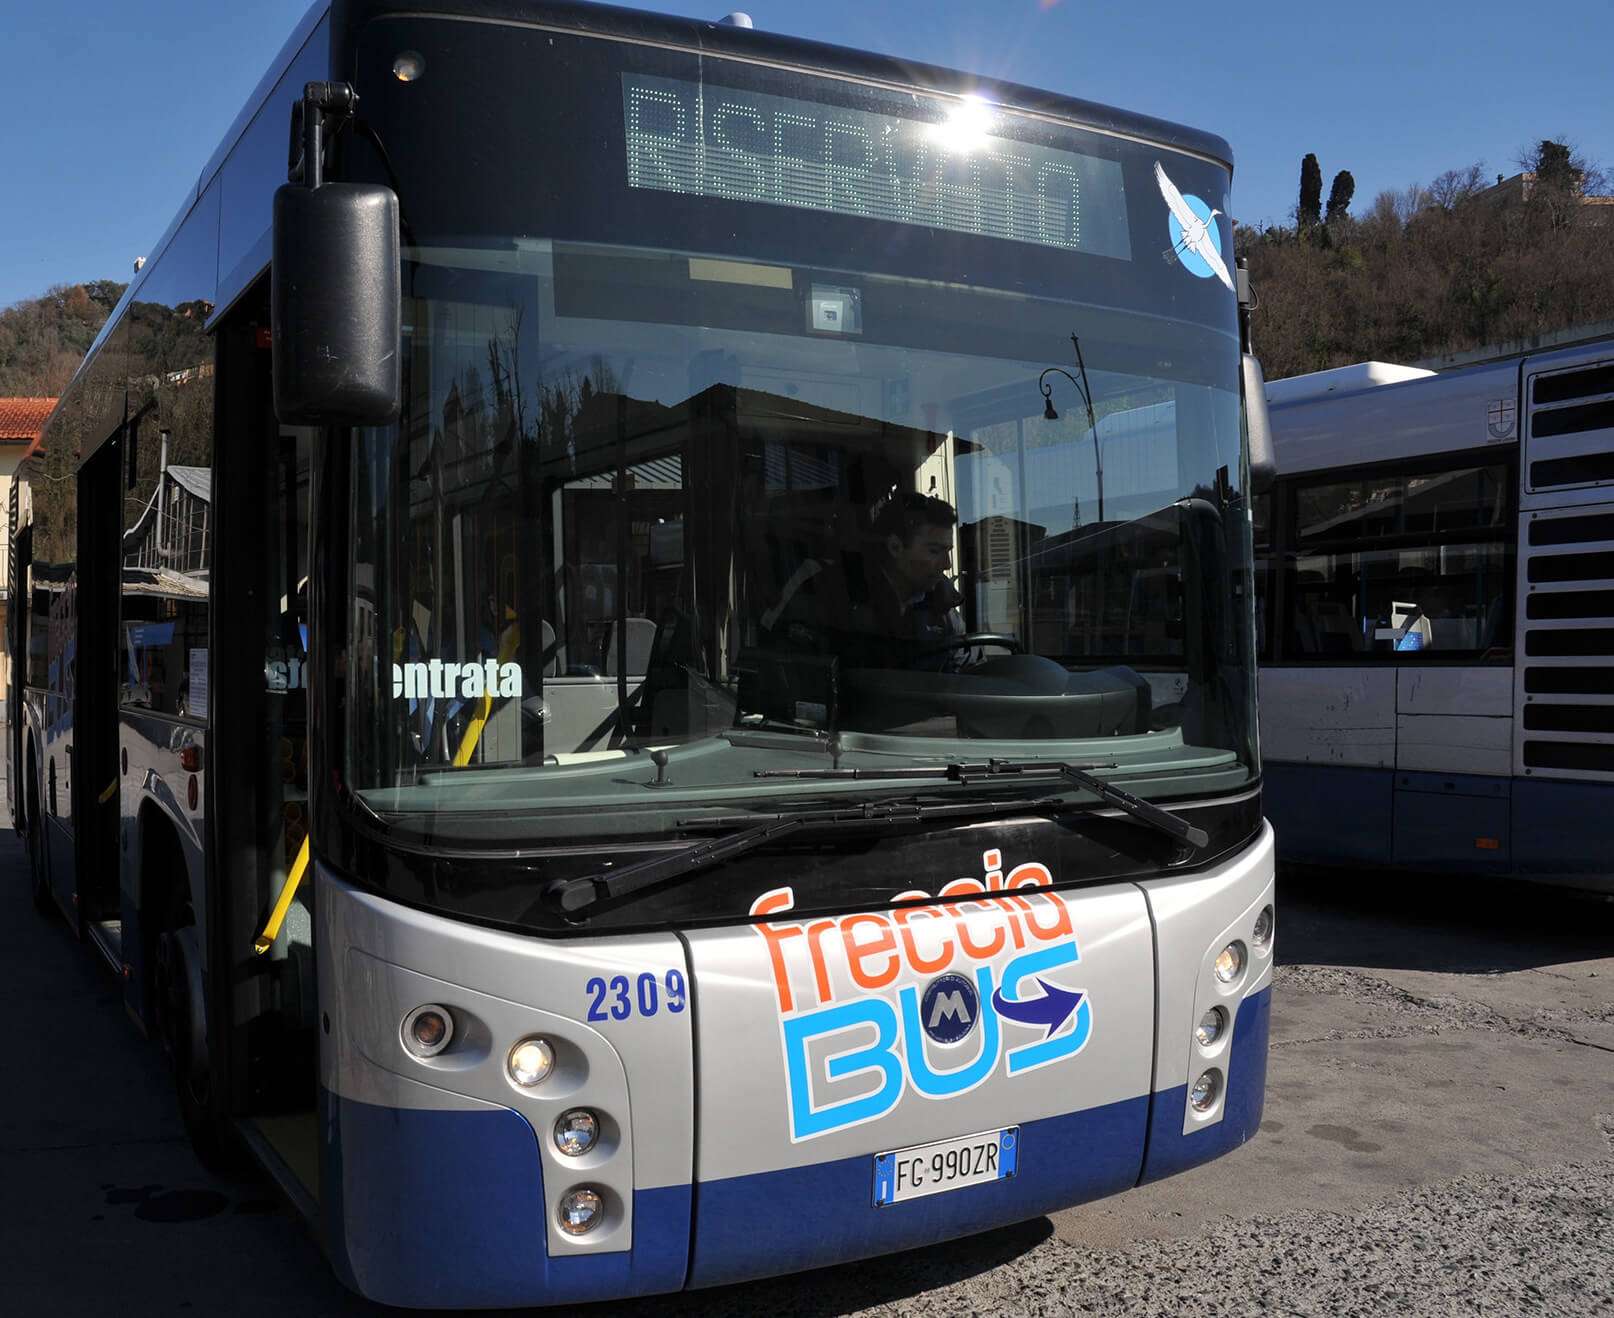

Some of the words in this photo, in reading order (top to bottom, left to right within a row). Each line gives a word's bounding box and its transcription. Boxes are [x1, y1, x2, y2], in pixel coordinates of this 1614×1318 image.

[586, 968, 686, 1023] 2309
[749, 848, 1074, 1014] freccia
[781, 939, 1094, 1143] BUS
